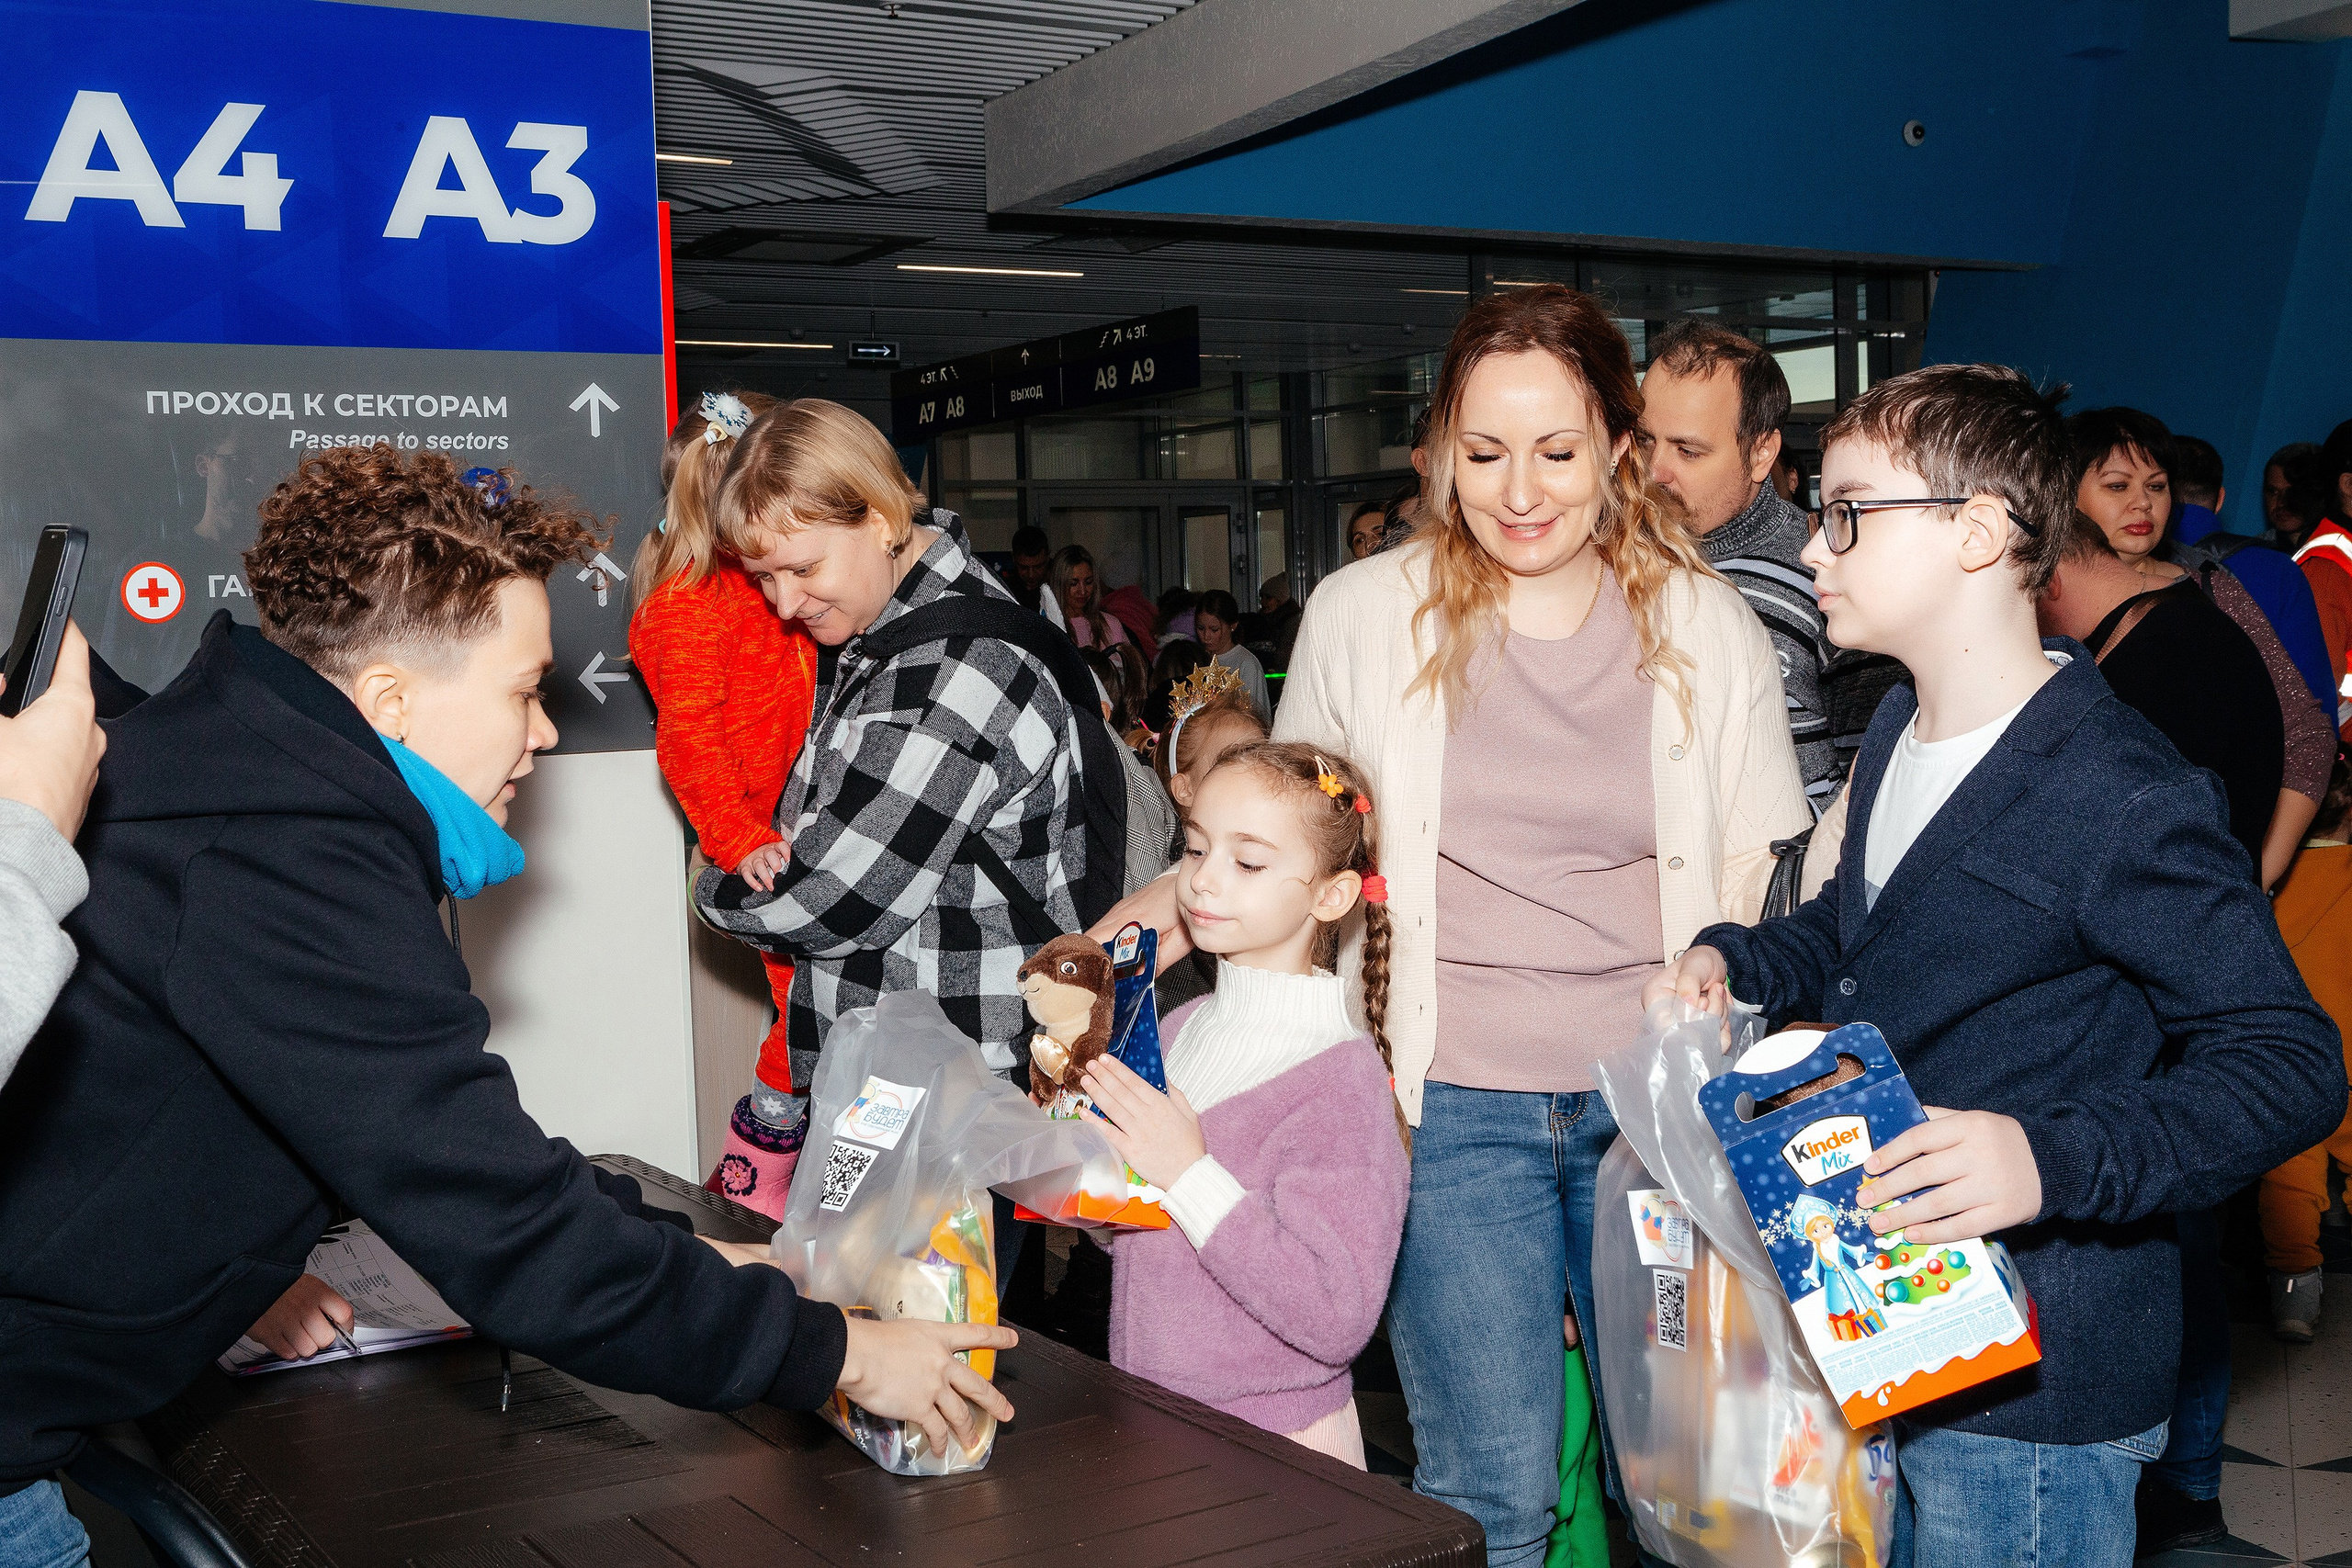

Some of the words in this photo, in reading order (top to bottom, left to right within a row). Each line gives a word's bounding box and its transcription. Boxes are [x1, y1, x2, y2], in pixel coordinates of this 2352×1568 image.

[24, 89, 295, 232] A4
[381, 115, 597, 246] A3
[1094, 365, 1118, 391] A8
[1130, 357, 1155, 385] A9
[146, 390, 295, 420] ПРОХОД
[304, 393, 325, 416] К
[334, 393, 508, 418] СЕКТОРАМ
[945, 395, 965, 419] A8
[1010, 385, 1044, 402] ВЫХОД
[397, 432, 419, 449] to
[426, 432, 509, 450] sectors
[1791, 1126, 1860, 1164] Kinder
[1821, 1151, 1854, 1176] Mix
